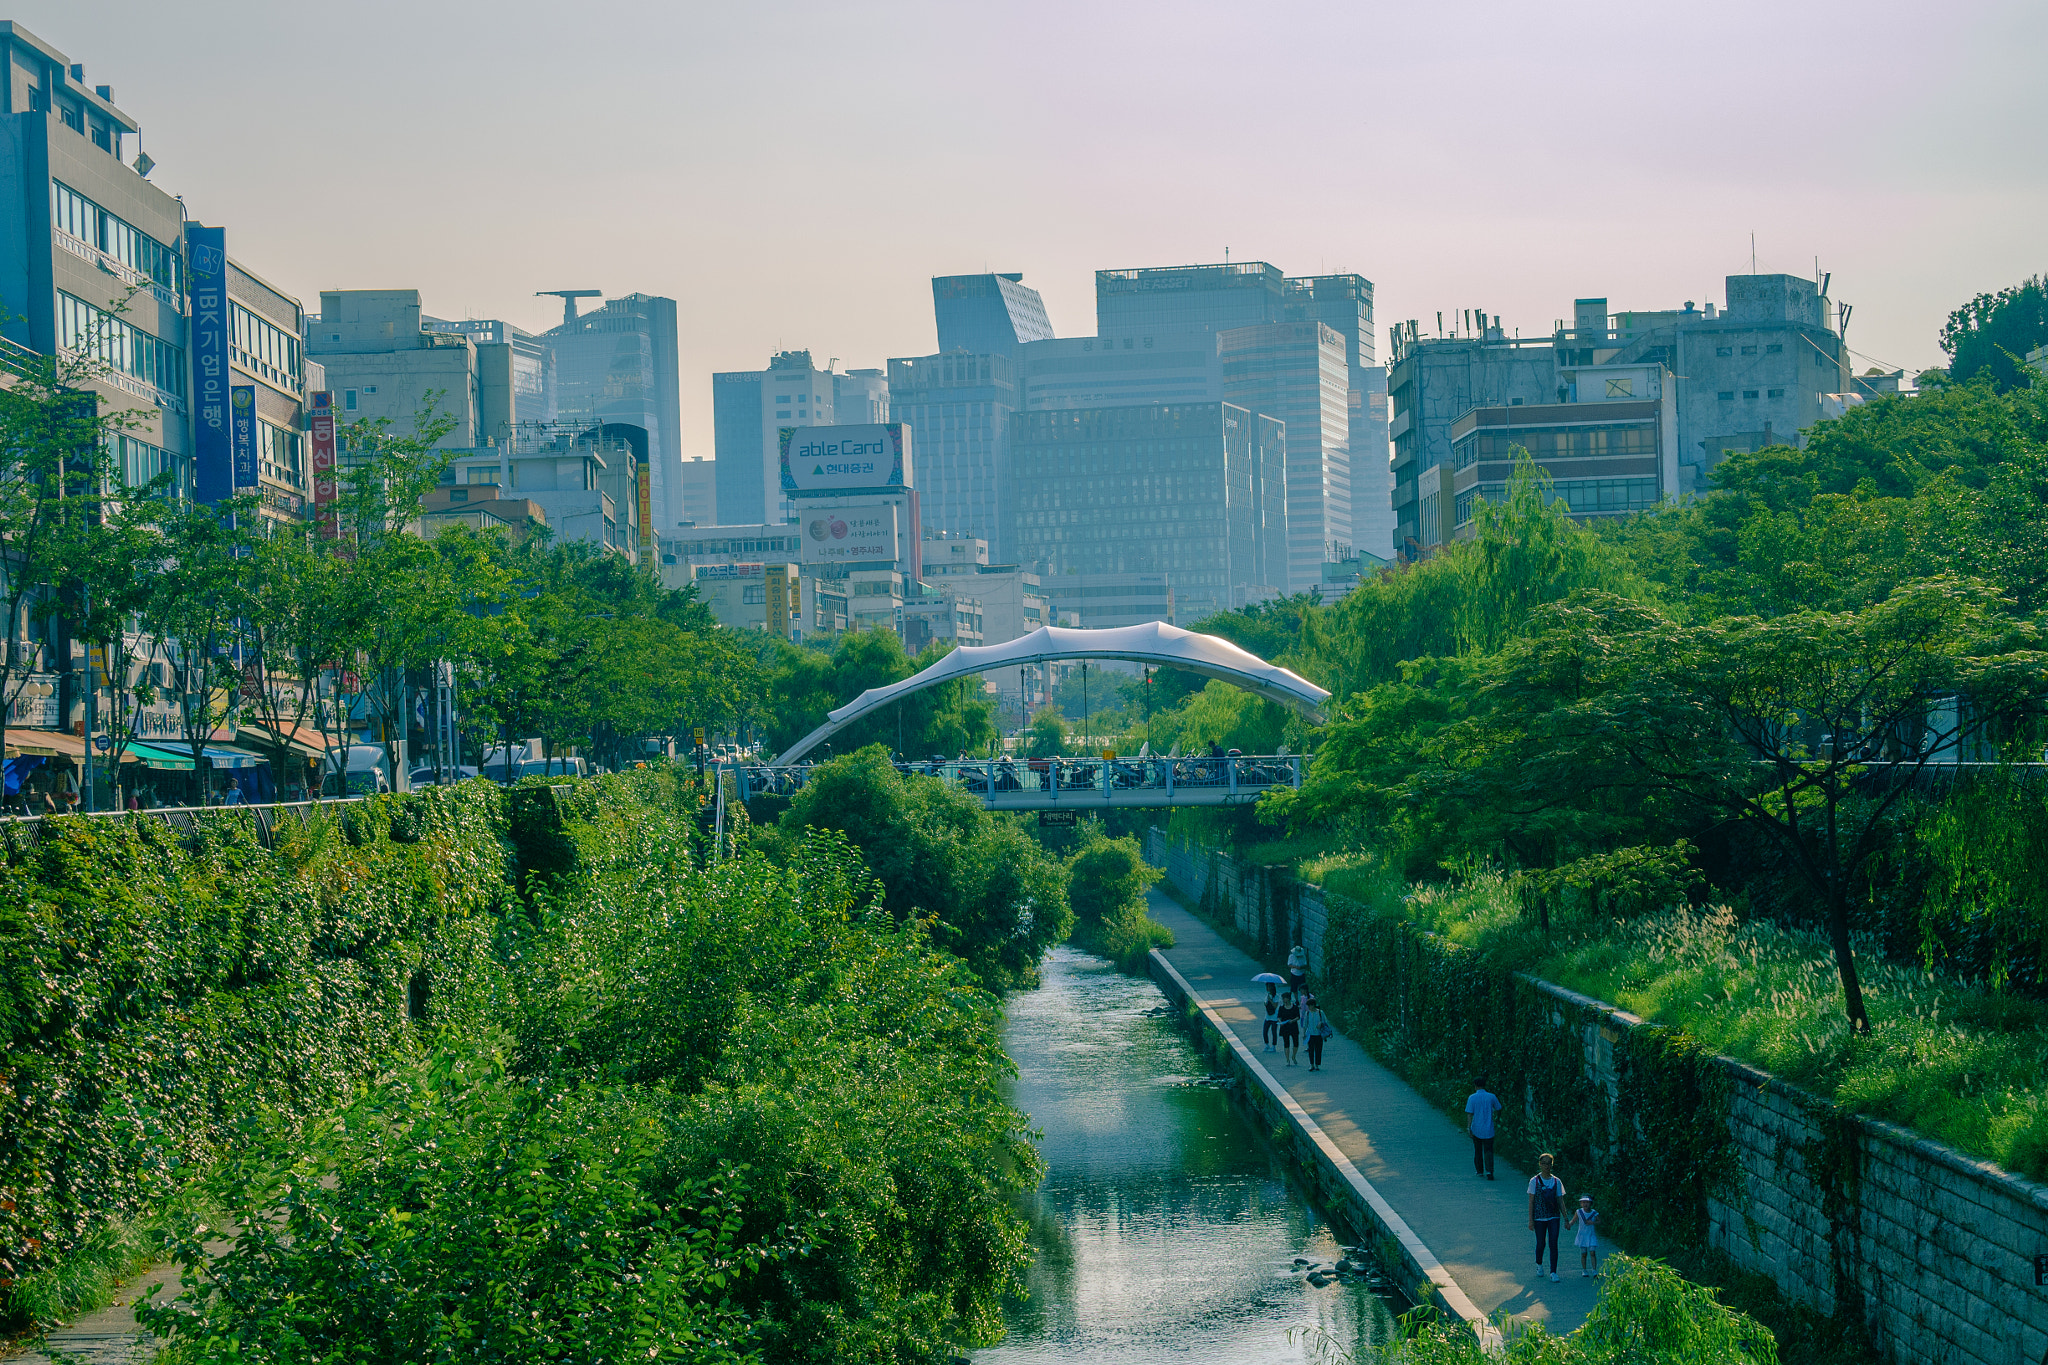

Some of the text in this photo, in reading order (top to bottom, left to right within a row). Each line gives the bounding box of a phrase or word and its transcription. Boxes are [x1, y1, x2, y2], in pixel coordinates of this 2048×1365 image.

[199, 287, 222, 428] IBK기업은행
[236, 419, 251, 474] 행복치과
[799, 439, 884, 457] able Card
[826, 462, 874, 475] 현대증권
[640, 476, 651, 537] HOTEL
[850, 545, 884, 556] 영주사과
[1043, 811, 1073, 821] 새벽다리
